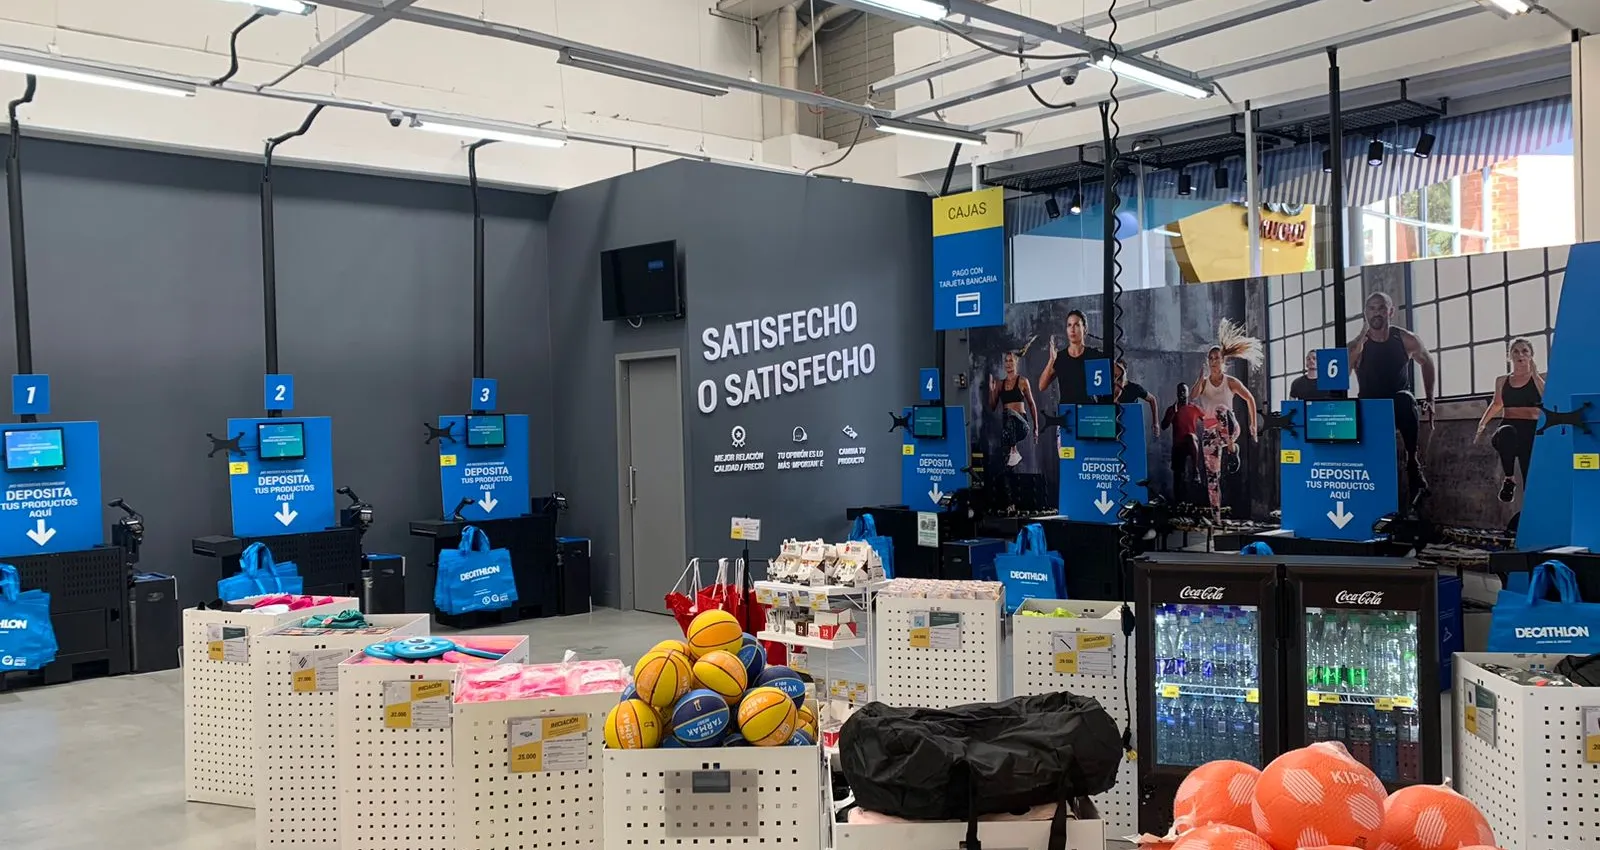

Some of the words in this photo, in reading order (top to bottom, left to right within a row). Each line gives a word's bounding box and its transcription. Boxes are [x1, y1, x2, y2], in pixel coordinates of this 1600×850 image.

[948, 202, 987, 220] CAJAS
[951, 268, 969, 277] PAGO
[970, 267, 983, 276] CON
[939, 278, 965, 288] TARJETA
[966, 275, 997, 285] BANCARIA
[702, 301, 858, 361] SATISFECHO
[1327, 359, 1339, 378] 6
[697, 379, 717, 414] O
[724, 343, 876, 407] SATISFECHO
[1094, 370, 1102, 386] 5
[926, 377, 933, 392] 4
[26, 386, 36, 404] 1
[275, 384, 286, 400] 2
[480, 387, 490, 402] 3
[777, 452, 786, 460] TU
[859, 446, 867, 454] TU
[714, 454, 735, 463] MEJOR
[736, 452, 764, 461] RELACIÓN
[837, 456, 865, 465] PRODUCTO
[919, 458, 953, 468] DEPOSITA
[714, 464, 739, 472] CALIDAD
[744, 462, 765, 471] PRECIO
[777, 461, 790, 469] MÁS
[464, 466, 509, 477] DEPOSITA
[1310, 469, 1370, 481] DEPOSITA
[258, 474, 310, 486] DEPOSITA
[475, 475, 513, 484] PRODUCTOS
[1096, 481, 1112, 489] AQUÍ
[270, 484, 315, 493] PRODUCTOS
[480, 483, 495, 491] AQUÍ
[1306, 481, 1322, 489] TUS
[1324, 481, 1375, 491] PRODUCTOS
[6, 487, 72, 501] DEPOSITA
[276, 492, 294, 501] AQUÍ
[1330, 490, 1351, 500] AQUÍ
[0, 502, 20, 511] TUS
[21, 499, 78, 509] PRODUCTOS
[29, 508, 52, 518] AQUÍ
[460, 565, 500, 582] DECATHLON
[1010, 570, 1048, 582] DECATHLON
[1180, 586, 1226, 600] Coca-Cola
[1335, 590, 1384, 605] Coca-Cola
[1514, 626, 1590, 638] DECATHLON
[550, 717, 579, 729] INICIACIÓN
[687, 717, 723, 737] TARMAK
